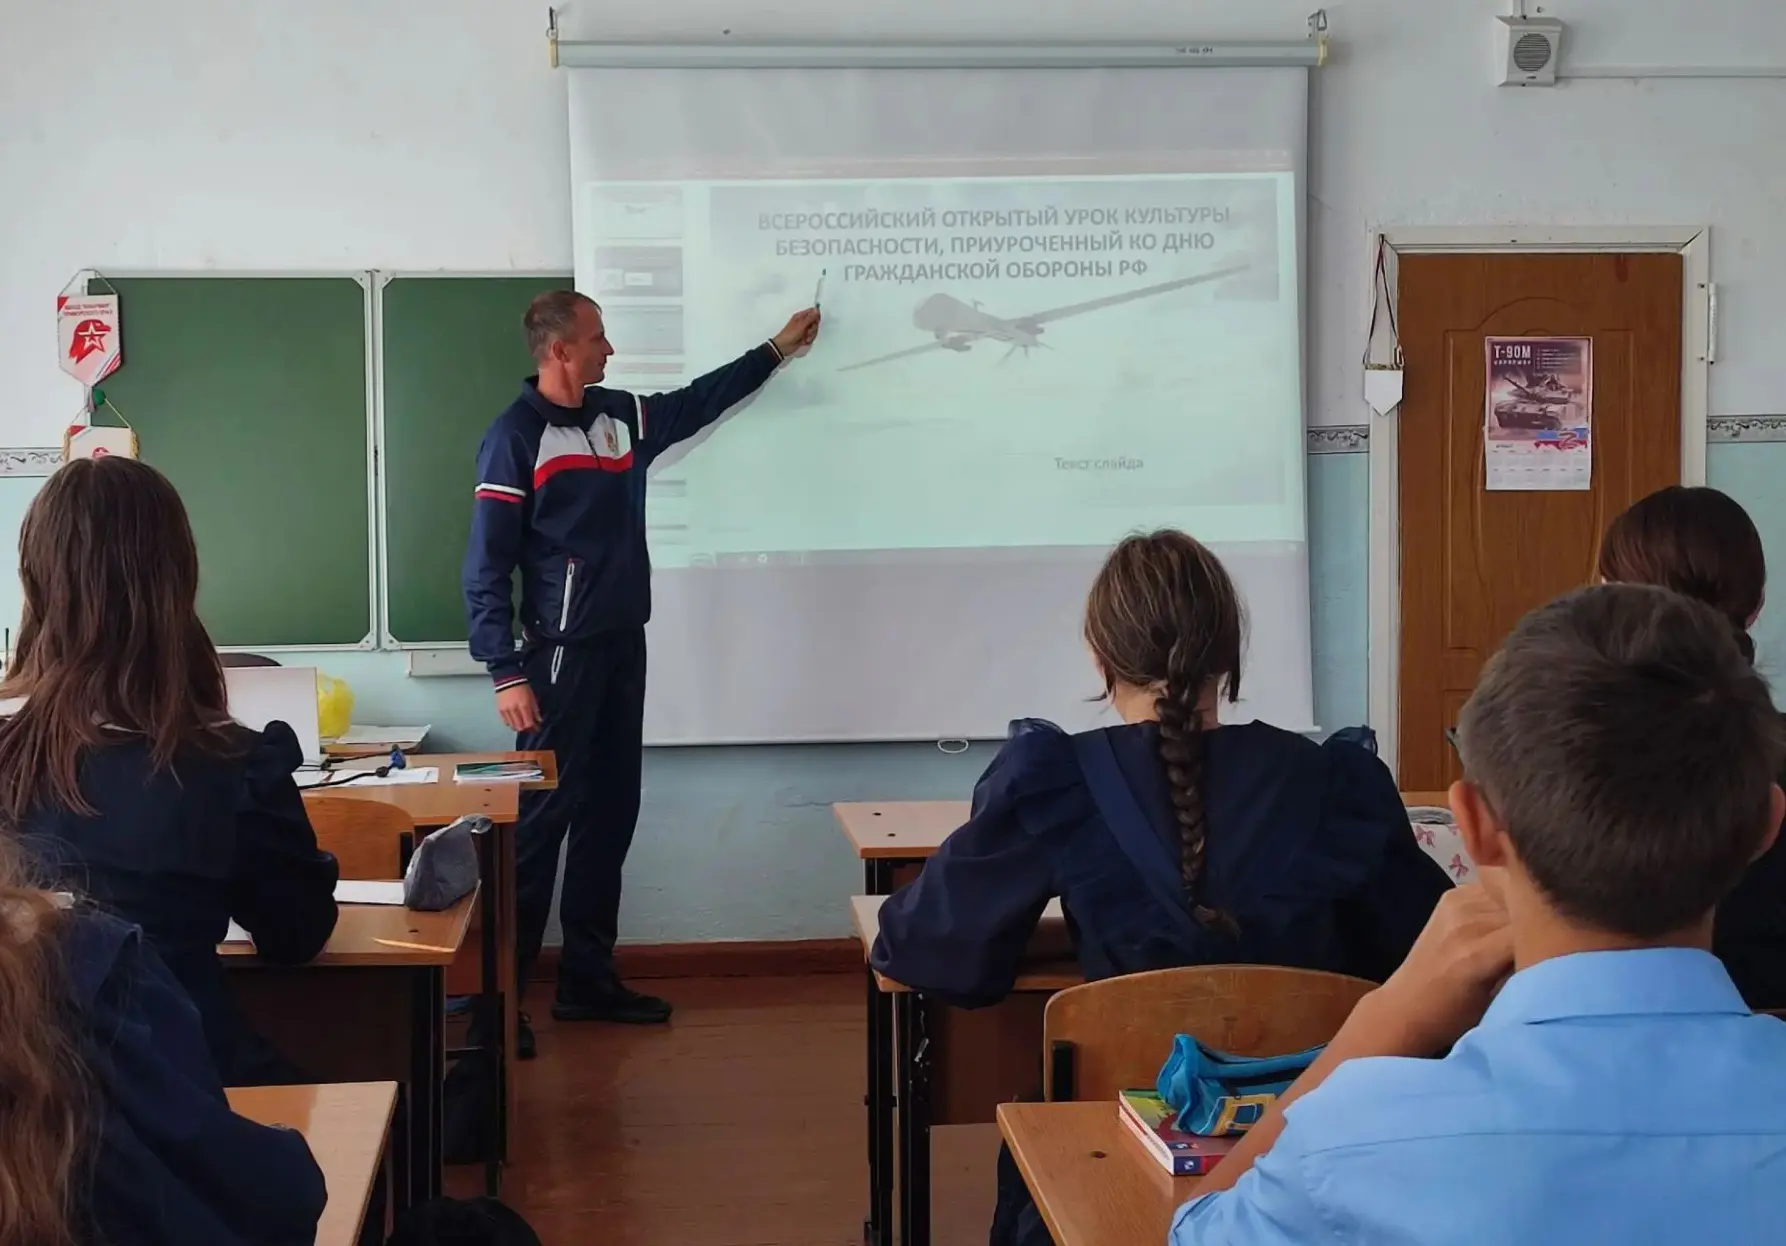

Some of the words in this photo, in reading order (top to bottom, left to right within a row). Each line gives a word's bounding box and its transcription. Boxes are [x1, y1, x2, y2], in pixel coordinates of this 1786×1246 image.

[758, 208, 936, 231] ВСЕРОССИЙСКИЙ
[941, 205, 1058, 228] ОТКРЫТЫЙ
[1064, 207, 1119, 227] УРОК
[1125, 206, 1230, 225] КУЛЬТУРЫ
[775, 237, 944, 257] БЕЗОПАСНОСТИ,
[950, 230, 1123, 254] ПРИУРОЧЕННЫЙ
[1129, 233, 1157, 251] КО
[1162, 232, 1216, 254] ДНЮ
[844, 258, 1000, 284] ГРАЖДАНСКОЙ
[1006, 260, 1112, 279] ОБОРОНЫ
[1119, 259, 1148, 277] РФ
[1054, 457, 1090, 471] Текст
[1094, 456, 1144, 471] слайда
